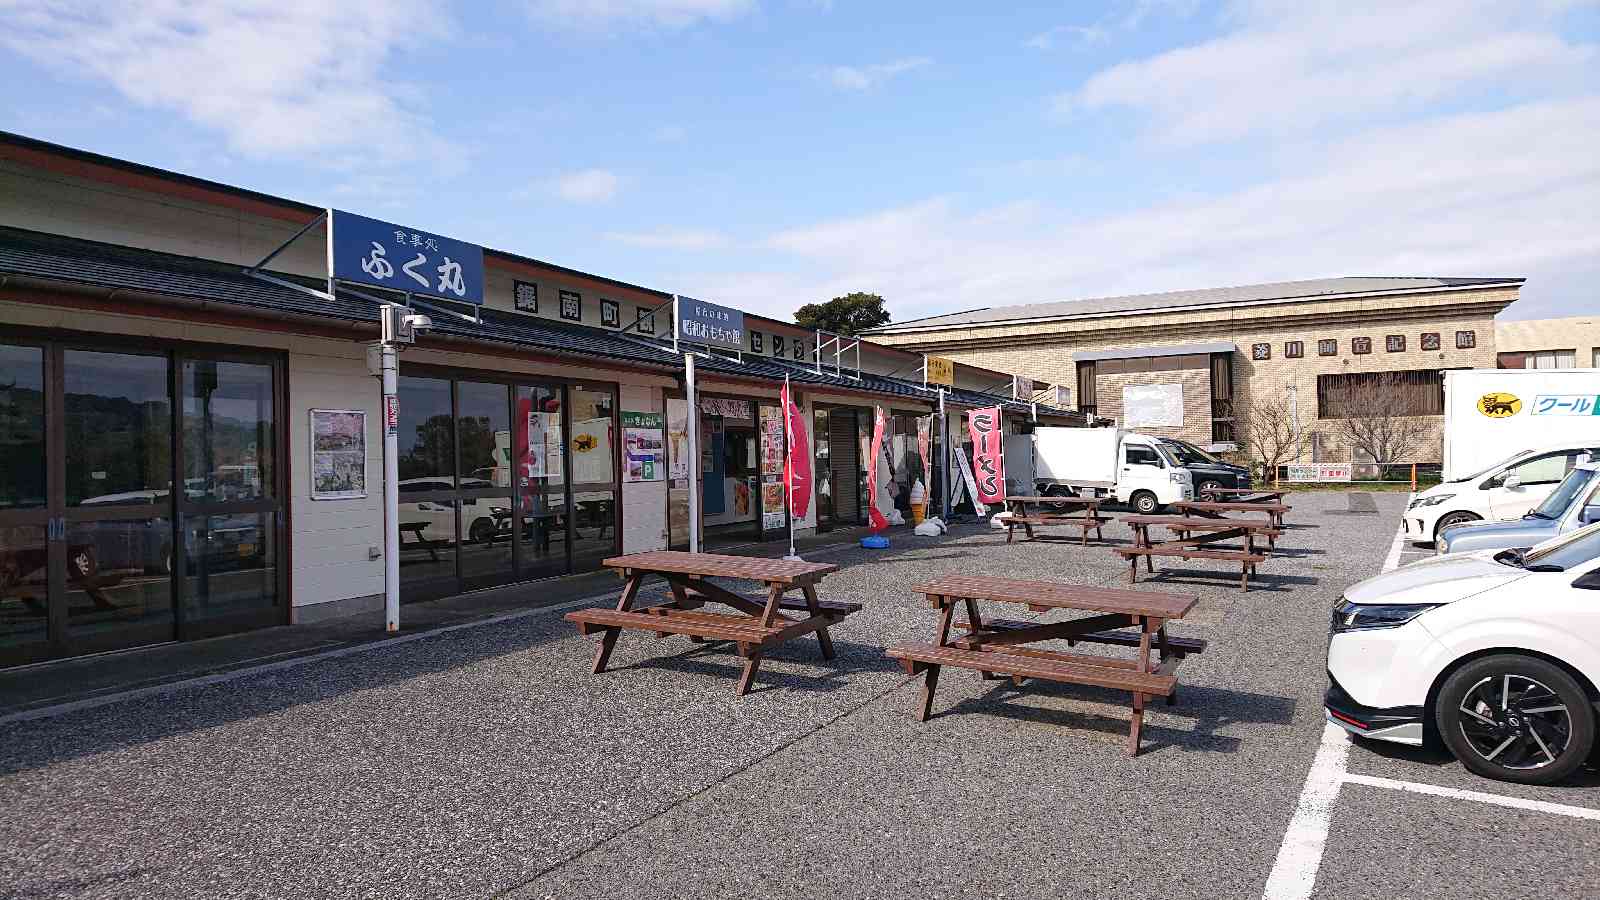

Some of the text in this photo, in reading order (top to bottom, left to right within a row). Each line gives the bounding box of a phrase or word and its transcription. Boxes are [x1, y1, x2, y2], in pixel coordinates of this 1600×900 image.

[393, 230, 438, 252] 食事処
[361, 241, 466, 297] ふく丸
[1538, 397, 1592, 414] クール
